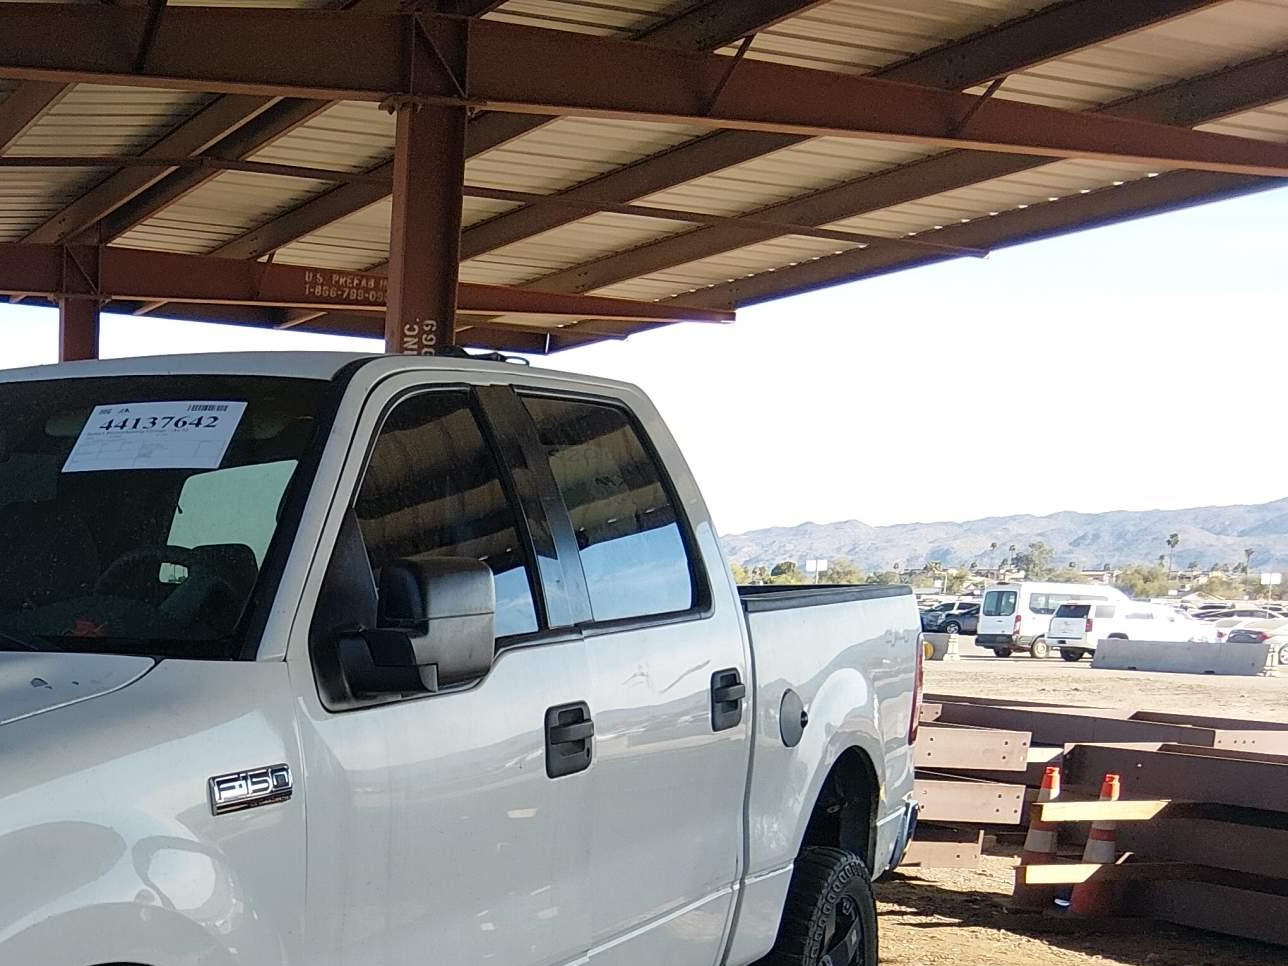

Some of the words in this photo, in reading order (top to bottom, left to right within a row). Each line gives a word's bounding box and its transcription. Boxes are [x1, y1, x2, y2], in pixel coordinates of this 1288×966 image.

[305, 271, 327, 285] U.S.
[332, 273, 376, 289] PREFAB
[305, 284, 387, 303] 1-866-799-09
[99, 415, 220, 431] 44137642
